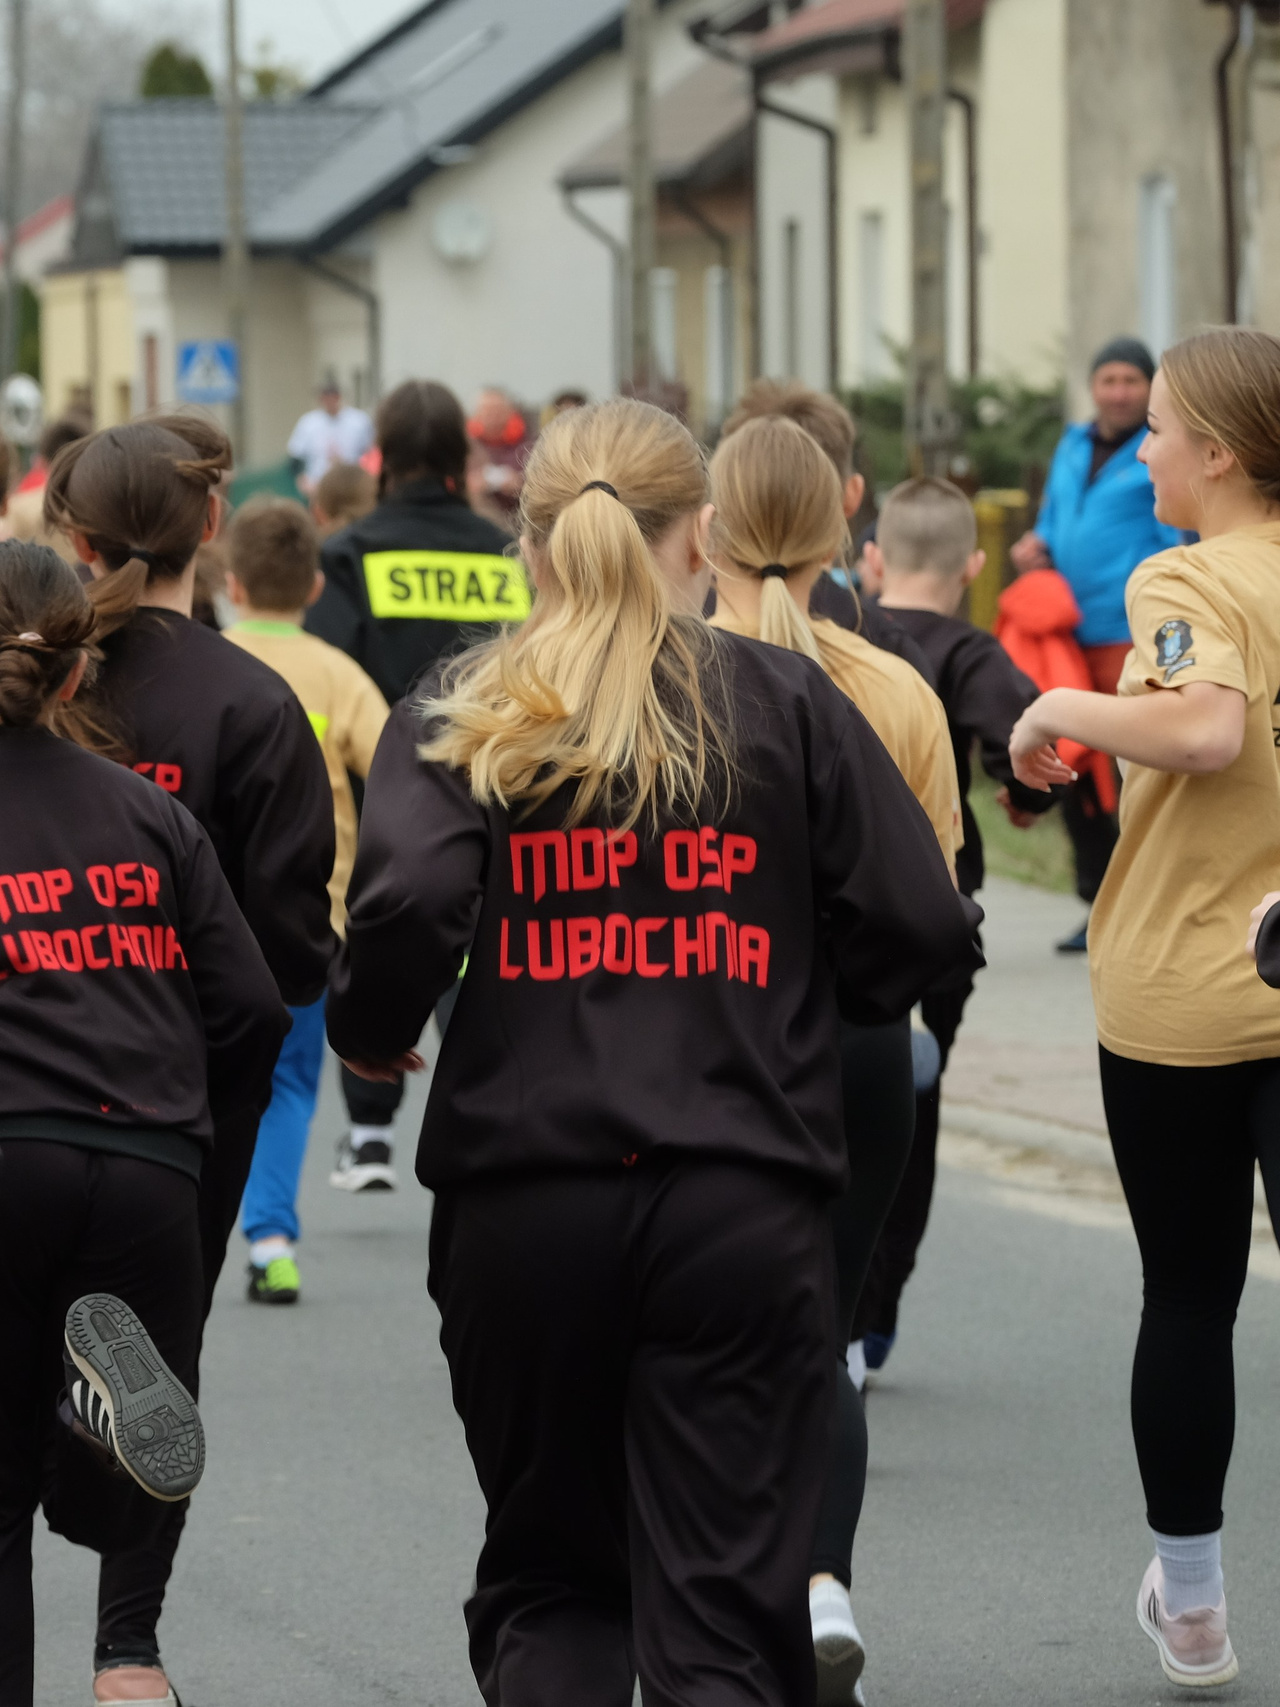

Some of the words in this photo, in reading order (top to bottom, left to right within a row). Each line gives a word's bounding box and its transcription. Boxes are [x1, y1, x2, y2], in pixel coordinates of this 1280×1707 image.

[85, 861, 161, 909] OSP
[509, 826, 639, 904] MDP
[662, 825, 758, 895] OSP
[499, 911, 772, 989] LUBOCHNIA
